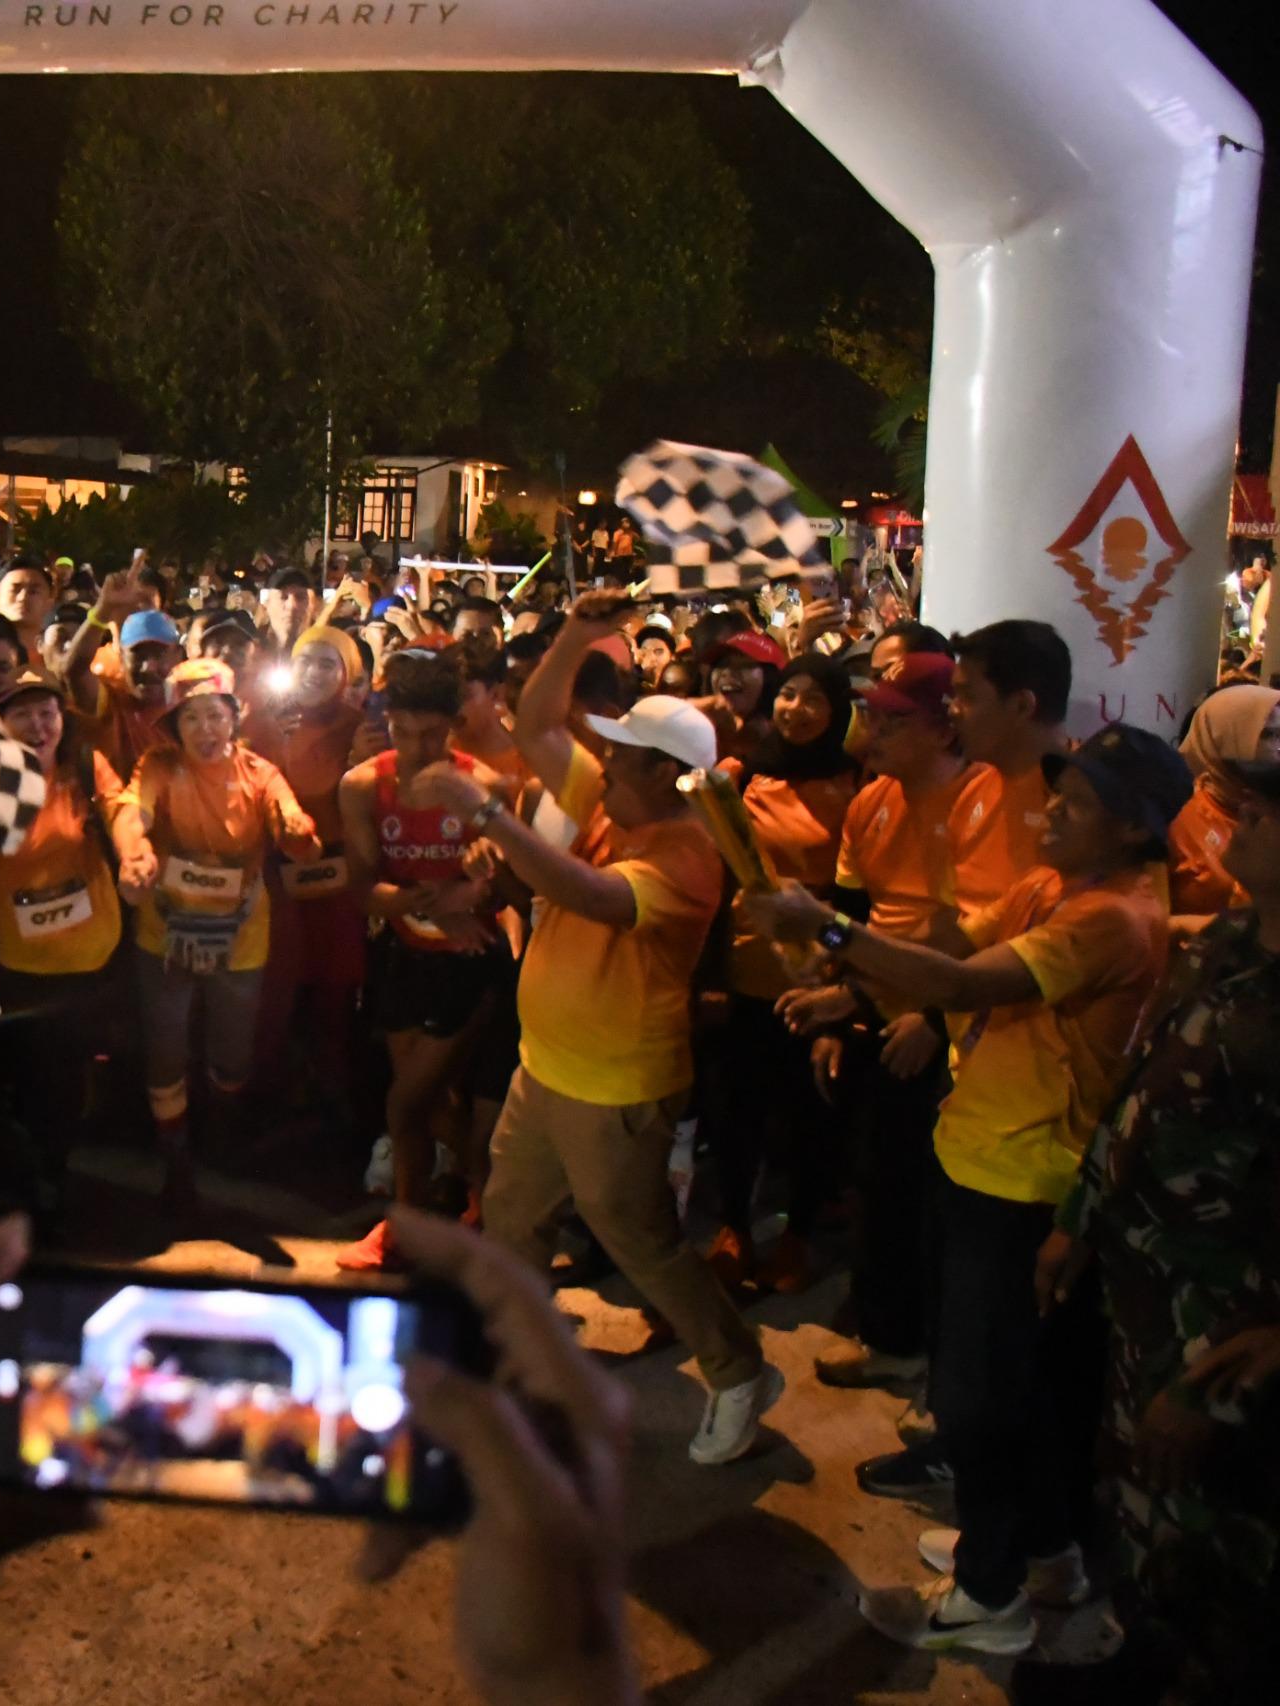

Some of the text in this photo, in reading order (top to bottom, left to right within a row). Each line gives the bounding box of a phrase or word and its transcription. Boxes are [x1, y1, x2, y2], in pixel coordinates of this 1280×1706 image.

[23, 4, 112, 28] RUN
[139, 4, 224, 27] FOR
[254, 3, 458, 26] CHARITY
[1097, 691, 1177, 723] UN
[381, 843, 467, 859] NDONESIA
